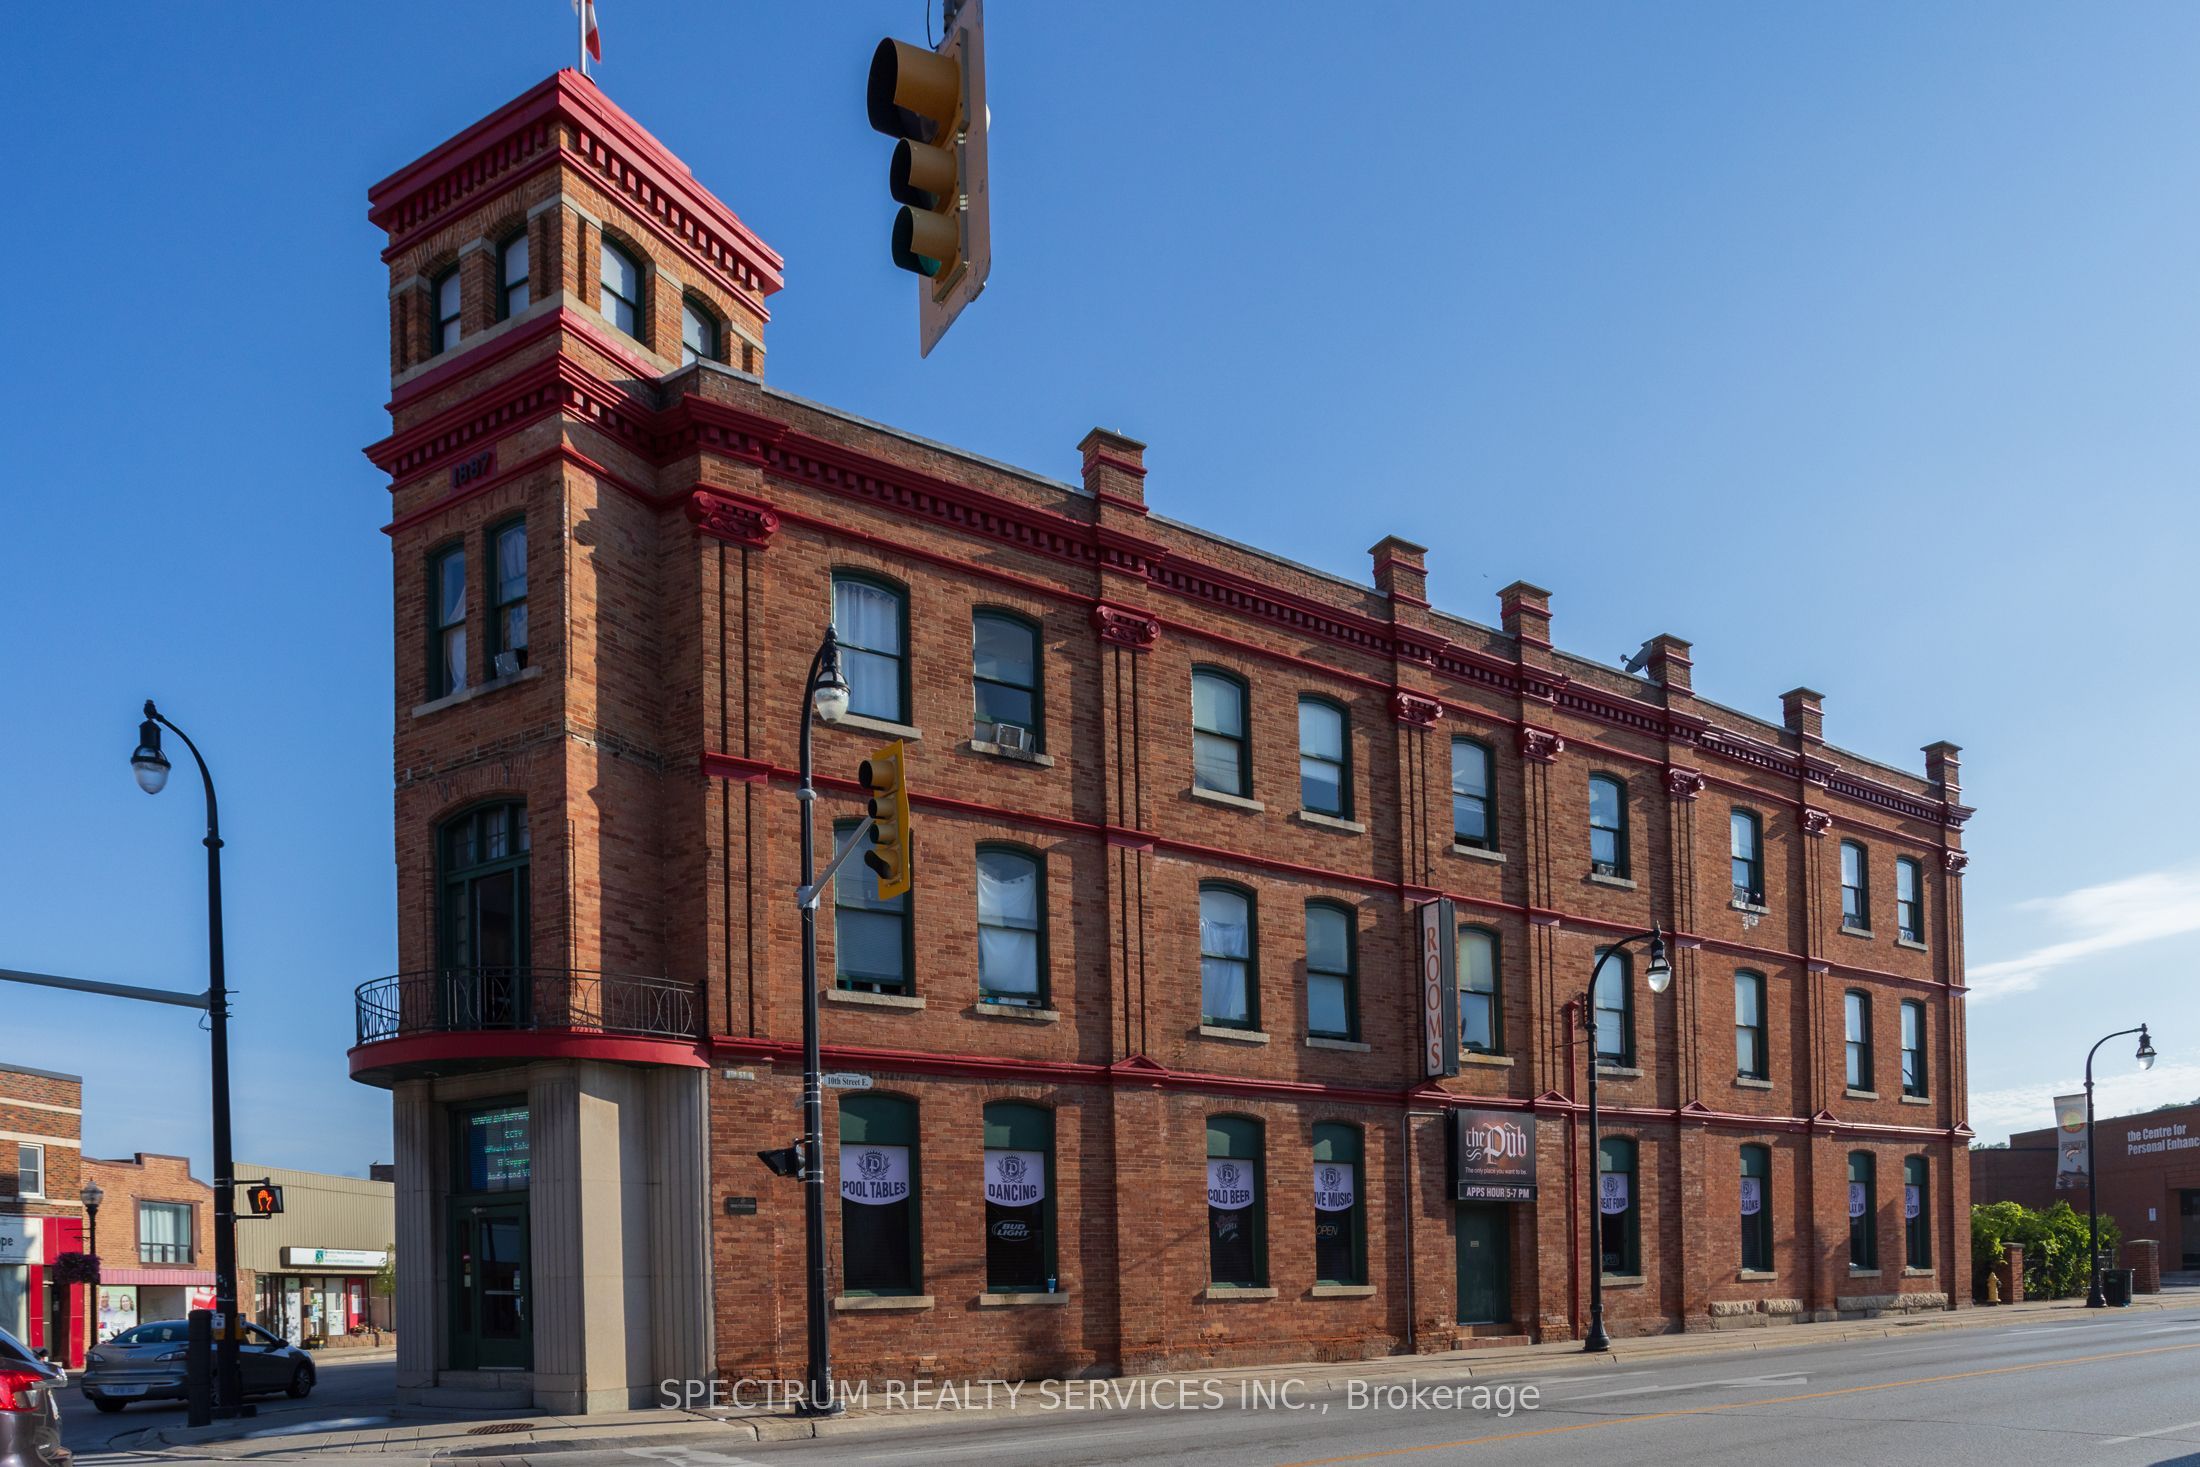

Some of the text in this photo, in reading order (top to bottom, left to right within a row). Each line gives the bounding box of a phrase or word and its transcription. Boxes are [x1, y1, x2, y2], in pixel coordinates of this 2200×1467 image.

[1426, 926, 1443, 1070] ROOMS
[827, 1077, 841, 1085] 10th
[842, 1077, 860, 1086] Street
[2127, 1124, 2187, 1142] the Centre for
[1465, 1122, 1527, 1165] the Pub
[2127, 1141, 2166, 1156] Personal
[1484, 1168, 1496, 1176] place
[842, 1181, 907, 1198] POOL TABLES
[988, 1184, 1037, 1201] DANCING
[1208, 1189, 1250, 1205] COLD BEER
[1466, 1187, 1530, 1199] APPS HOUR 5-7 PM
[1314, 1191, 1352, 1208] IVE MUSIC
[1600, 1197, 1612, 1209] REAT
[997, 1229, 1030, 1237] LIGHT
[1002, 1223, 1026, 1231] BUD
[1316, 1224, 1338, 1236] OPEN
